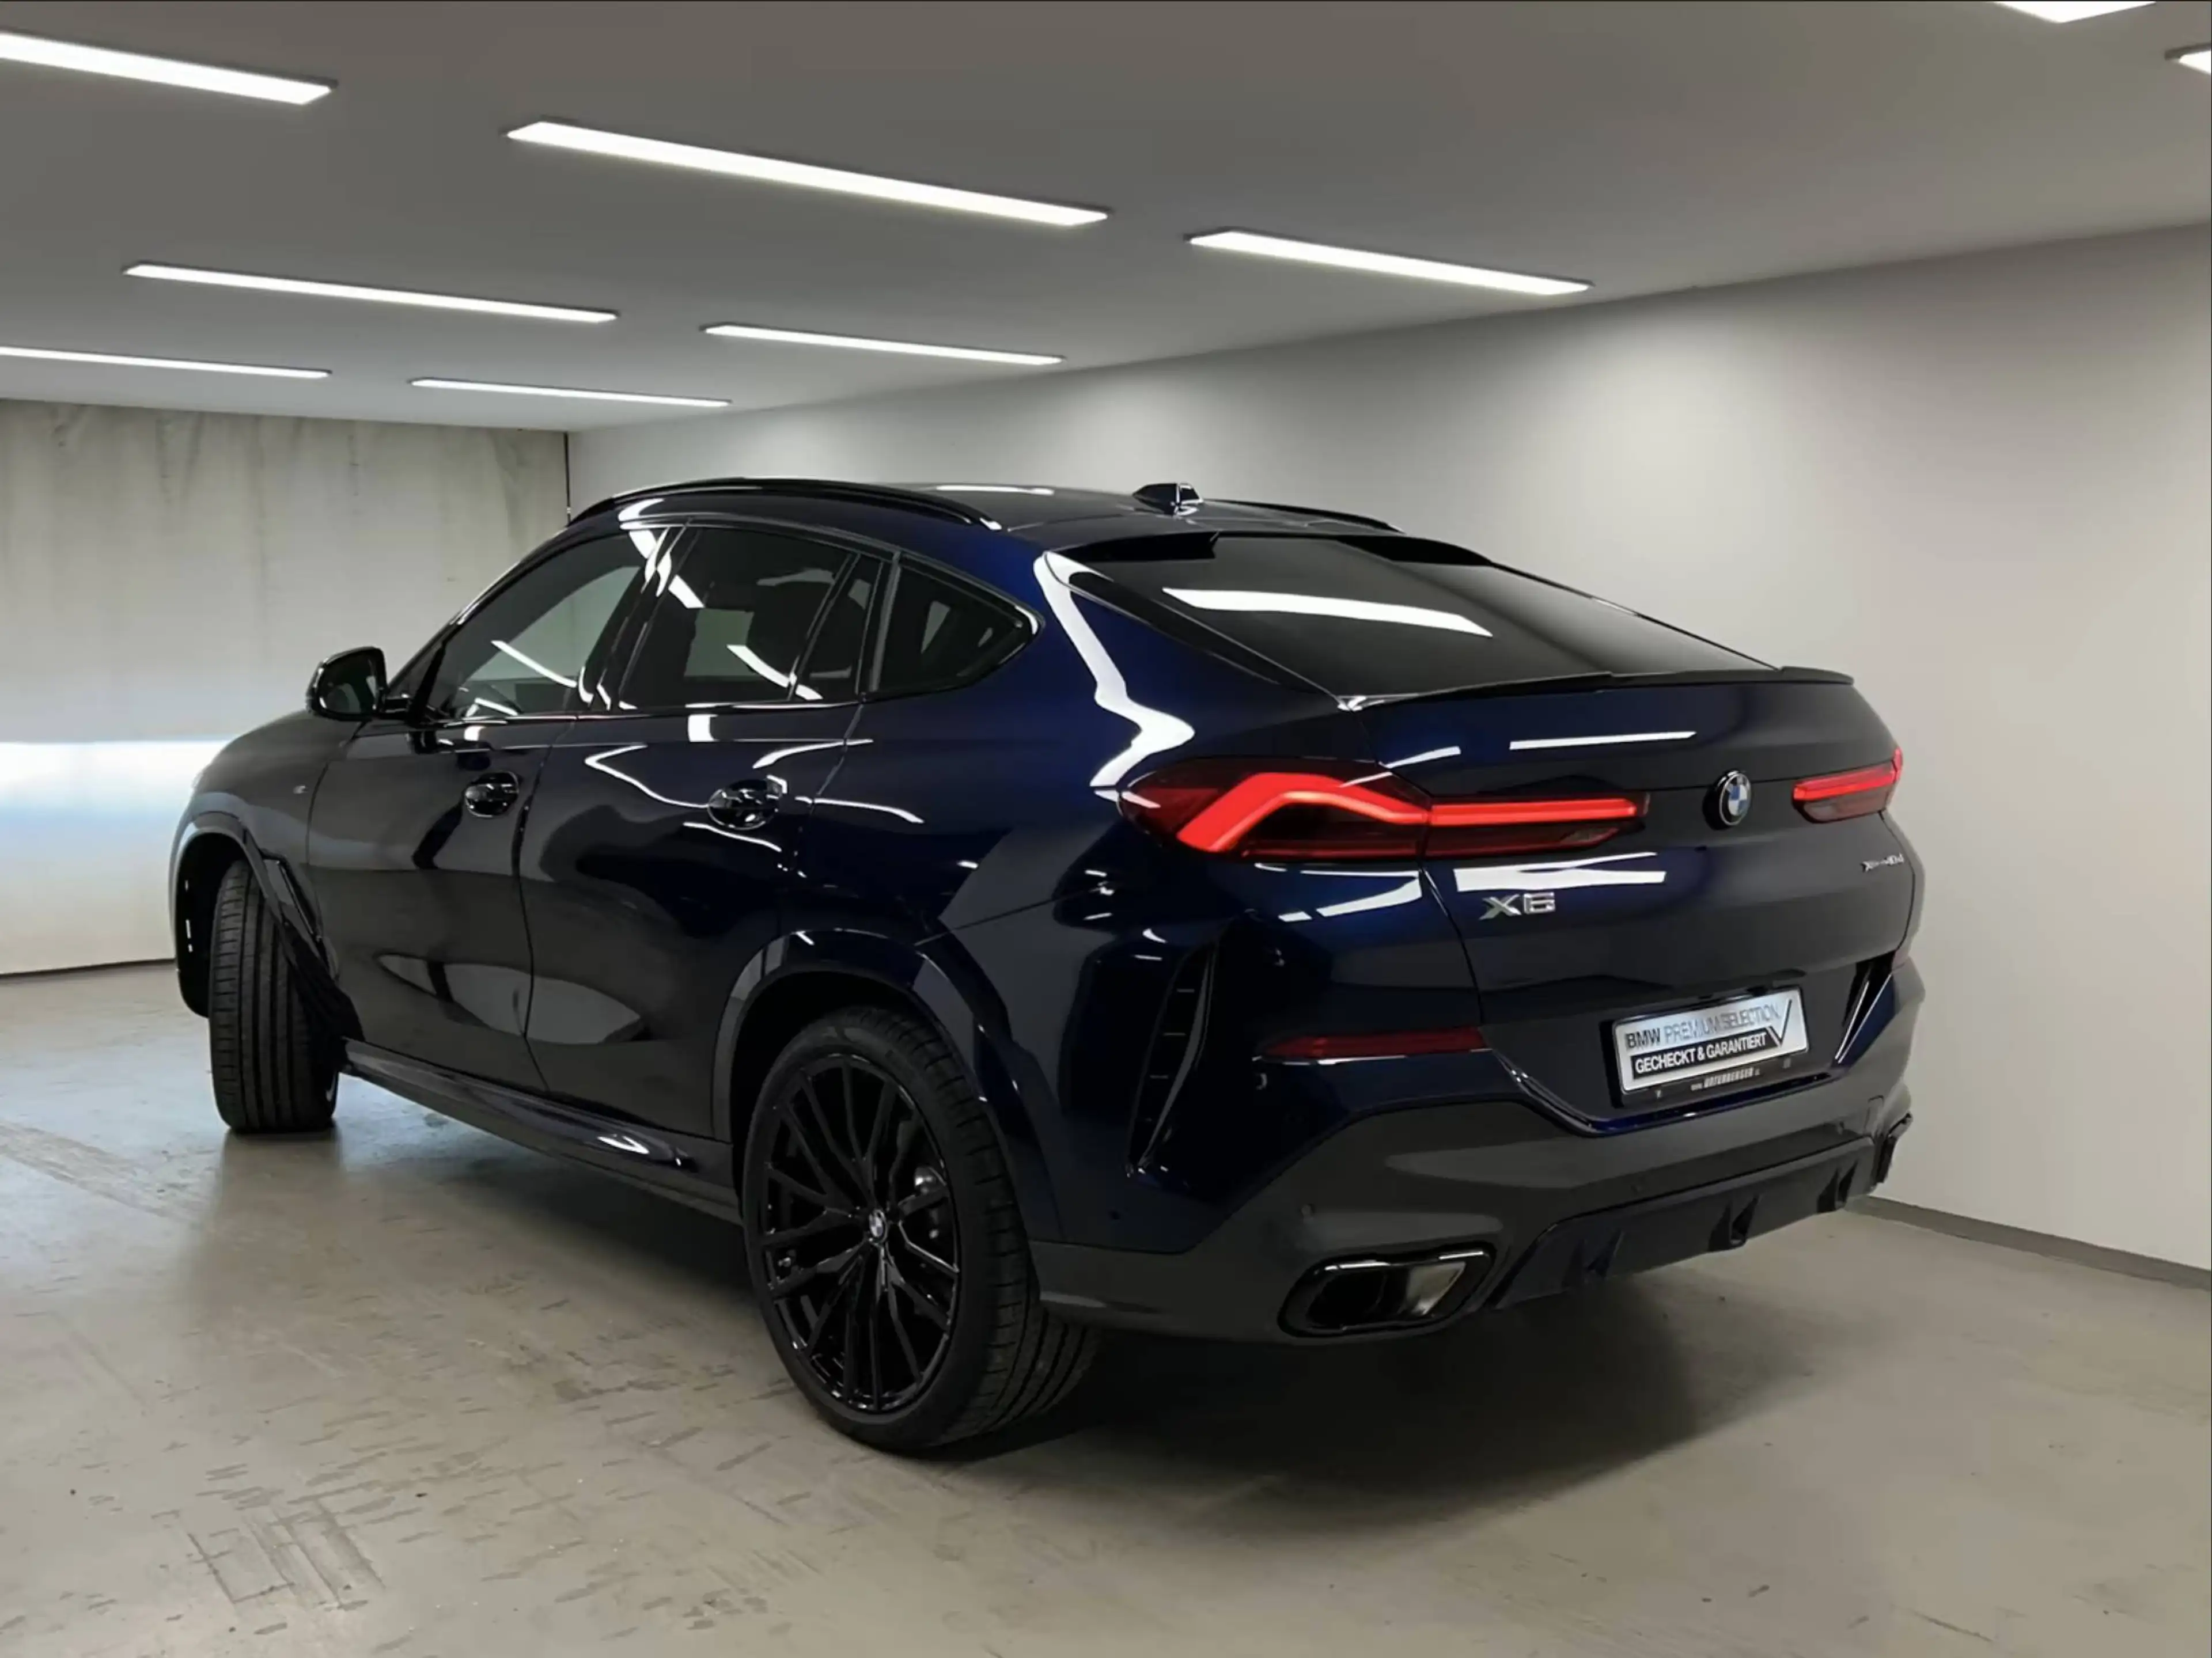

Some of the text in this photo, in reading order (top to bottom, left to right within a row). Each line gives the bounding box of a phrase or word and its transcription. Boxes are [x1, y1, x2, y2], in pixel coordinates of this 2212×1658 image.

[1479, 891, 1555, 920] X6
[1626, 1004, 1781, 1049] BMW PREMIUM SELECTION
[1635, 1031, 1767, 1073] GECHECKT & GARANTIERT
